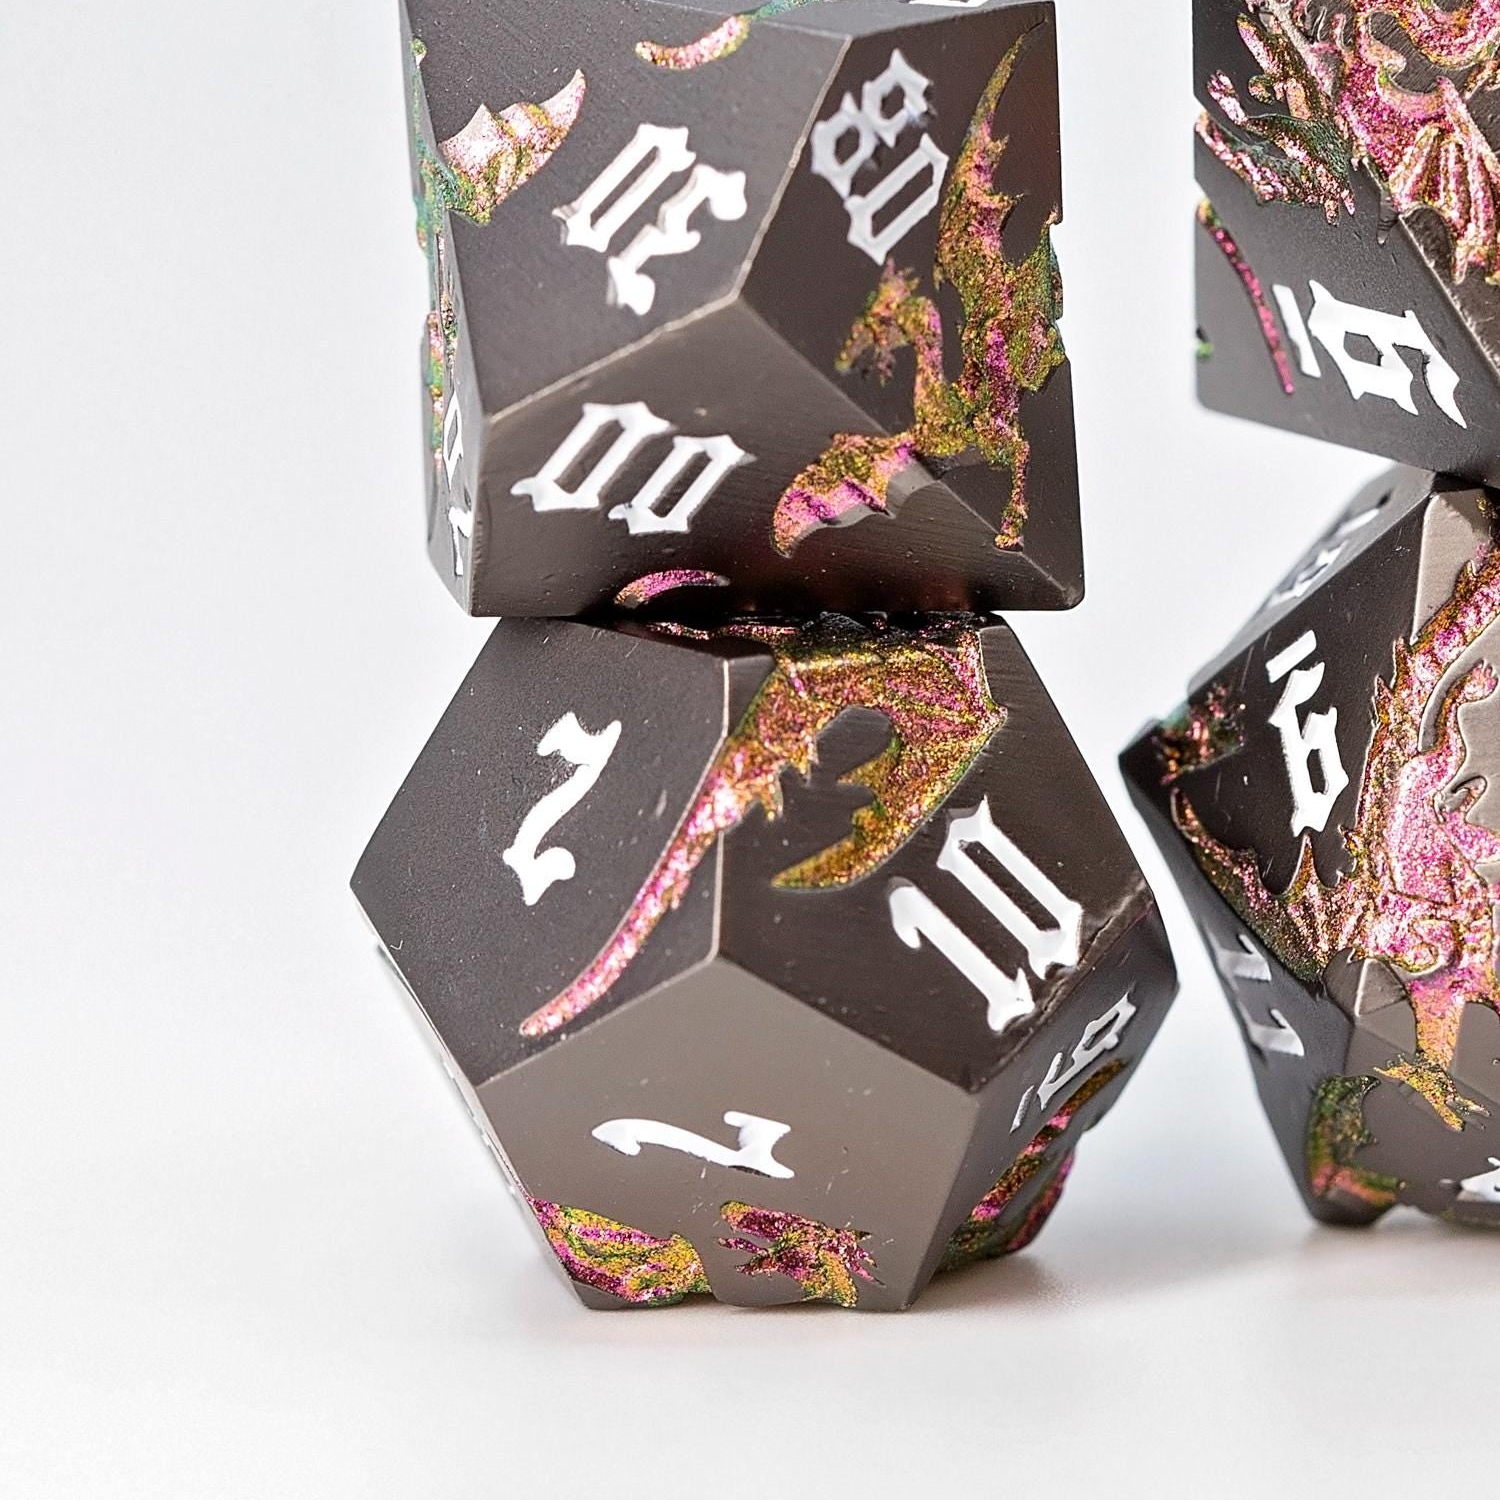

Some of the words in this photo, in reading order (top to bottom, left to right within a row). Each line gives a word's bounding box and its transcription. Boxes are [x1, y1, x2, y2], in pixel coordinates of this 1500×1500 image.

[812, 49, 949, 265] 80
[510, 401, 756, 536] 00
[889, 795, 1083, 1033] 10
